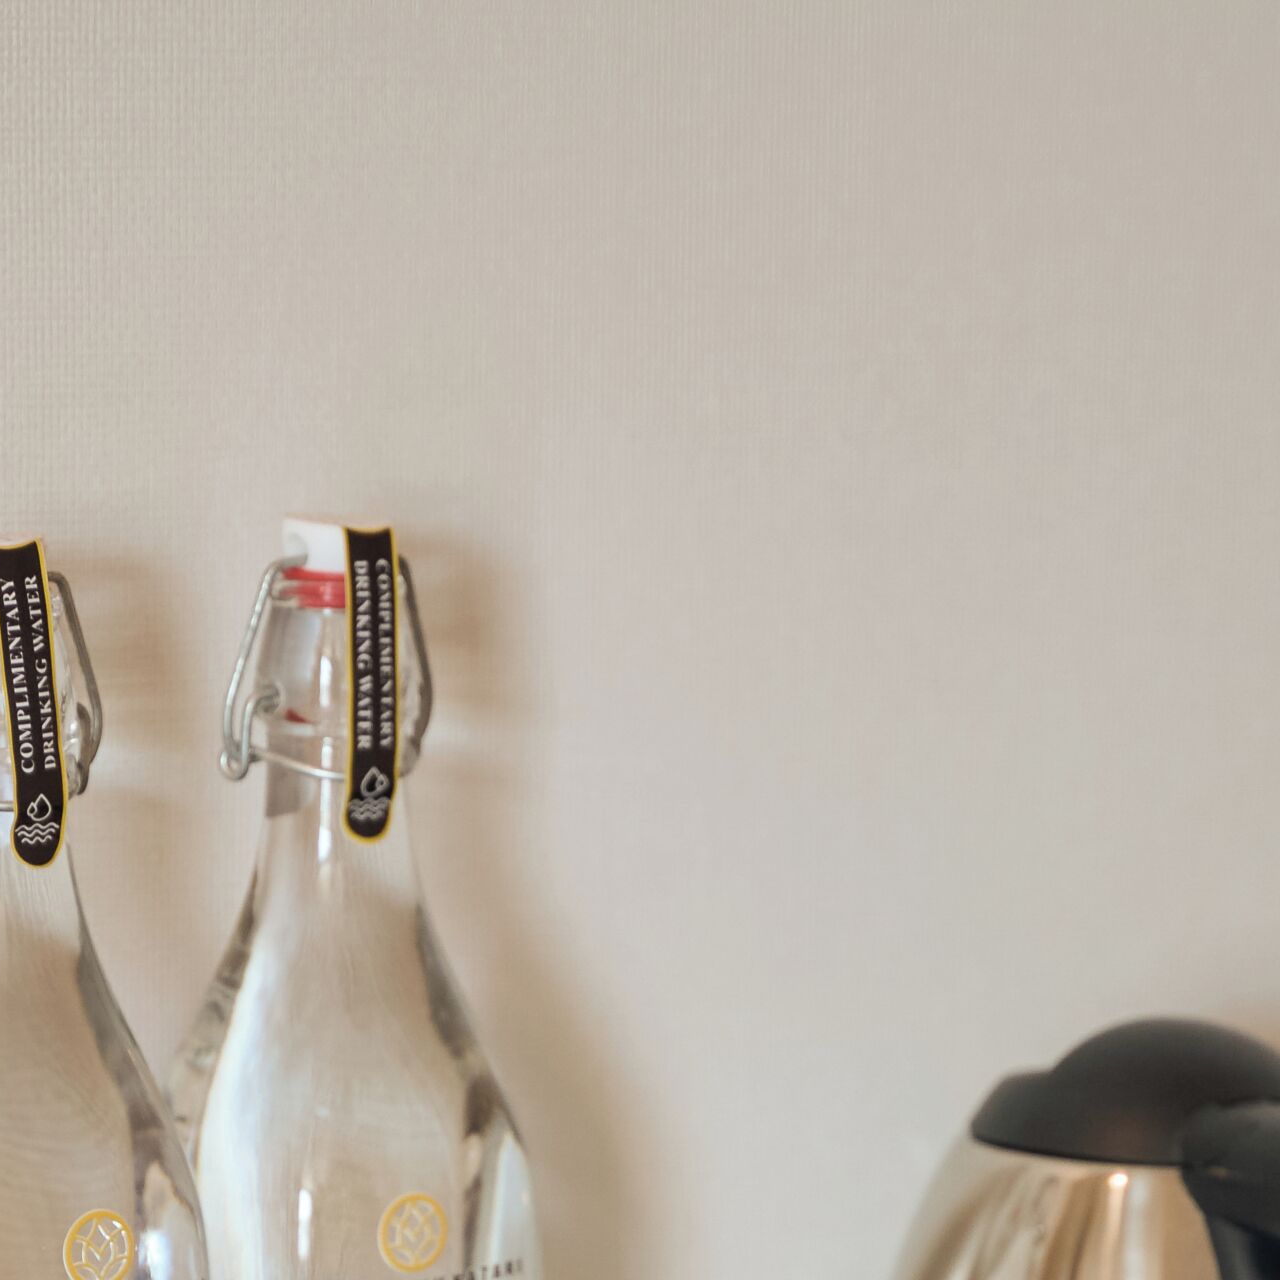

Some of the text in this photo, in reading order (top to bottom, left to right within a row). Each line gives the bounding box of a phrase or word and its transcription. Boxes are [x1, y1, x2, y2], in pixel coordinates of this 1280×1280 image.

[0, 577, 35, 775] COMPLIMENTARY
[24, 574, 57, 770] DRINKING WATER
[354, 560, 373, 750] DRINKING WATER
[375, 558, 395, 748] COMPLIMENTARY
